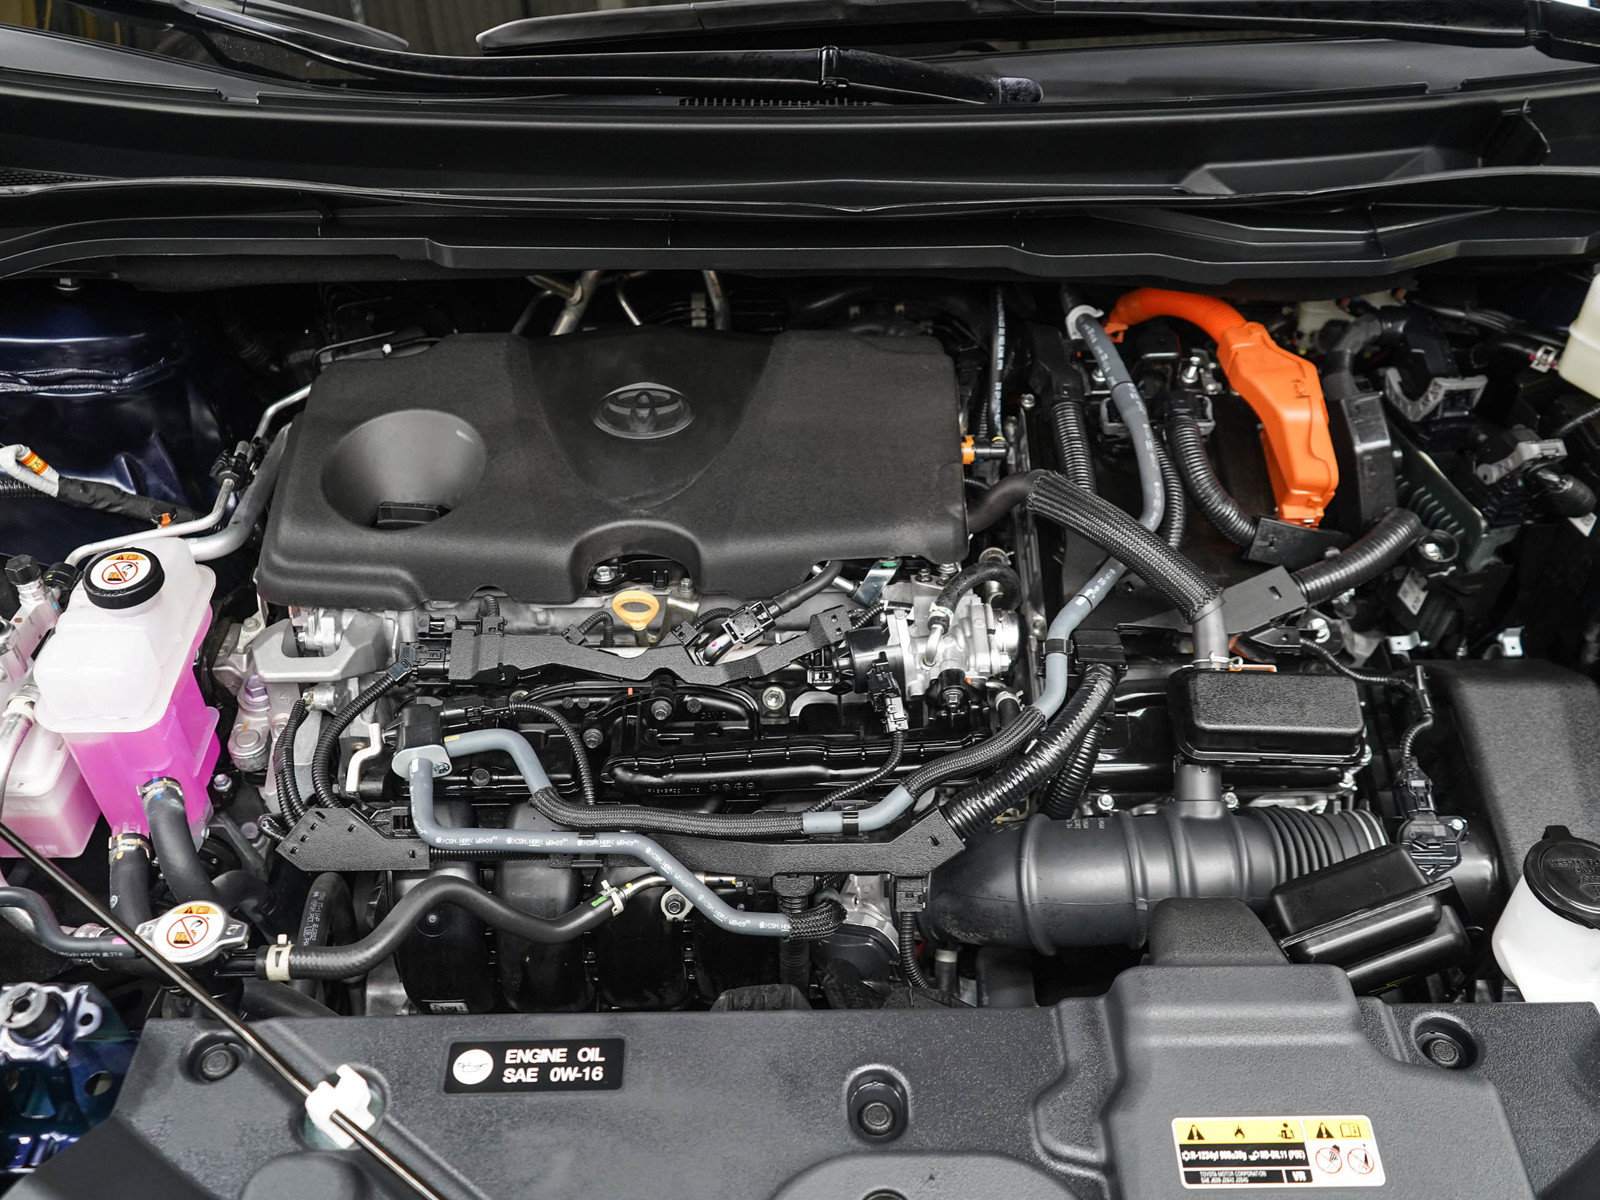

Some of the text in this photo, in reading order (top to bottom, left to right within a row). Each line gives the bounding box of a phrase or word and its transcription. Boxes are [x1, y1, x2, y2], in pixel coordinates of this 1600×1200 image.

[504, 1047, 605, 1064] ENGINE OIL
[502, 1066, 604, 1083] SAE 0W-16
